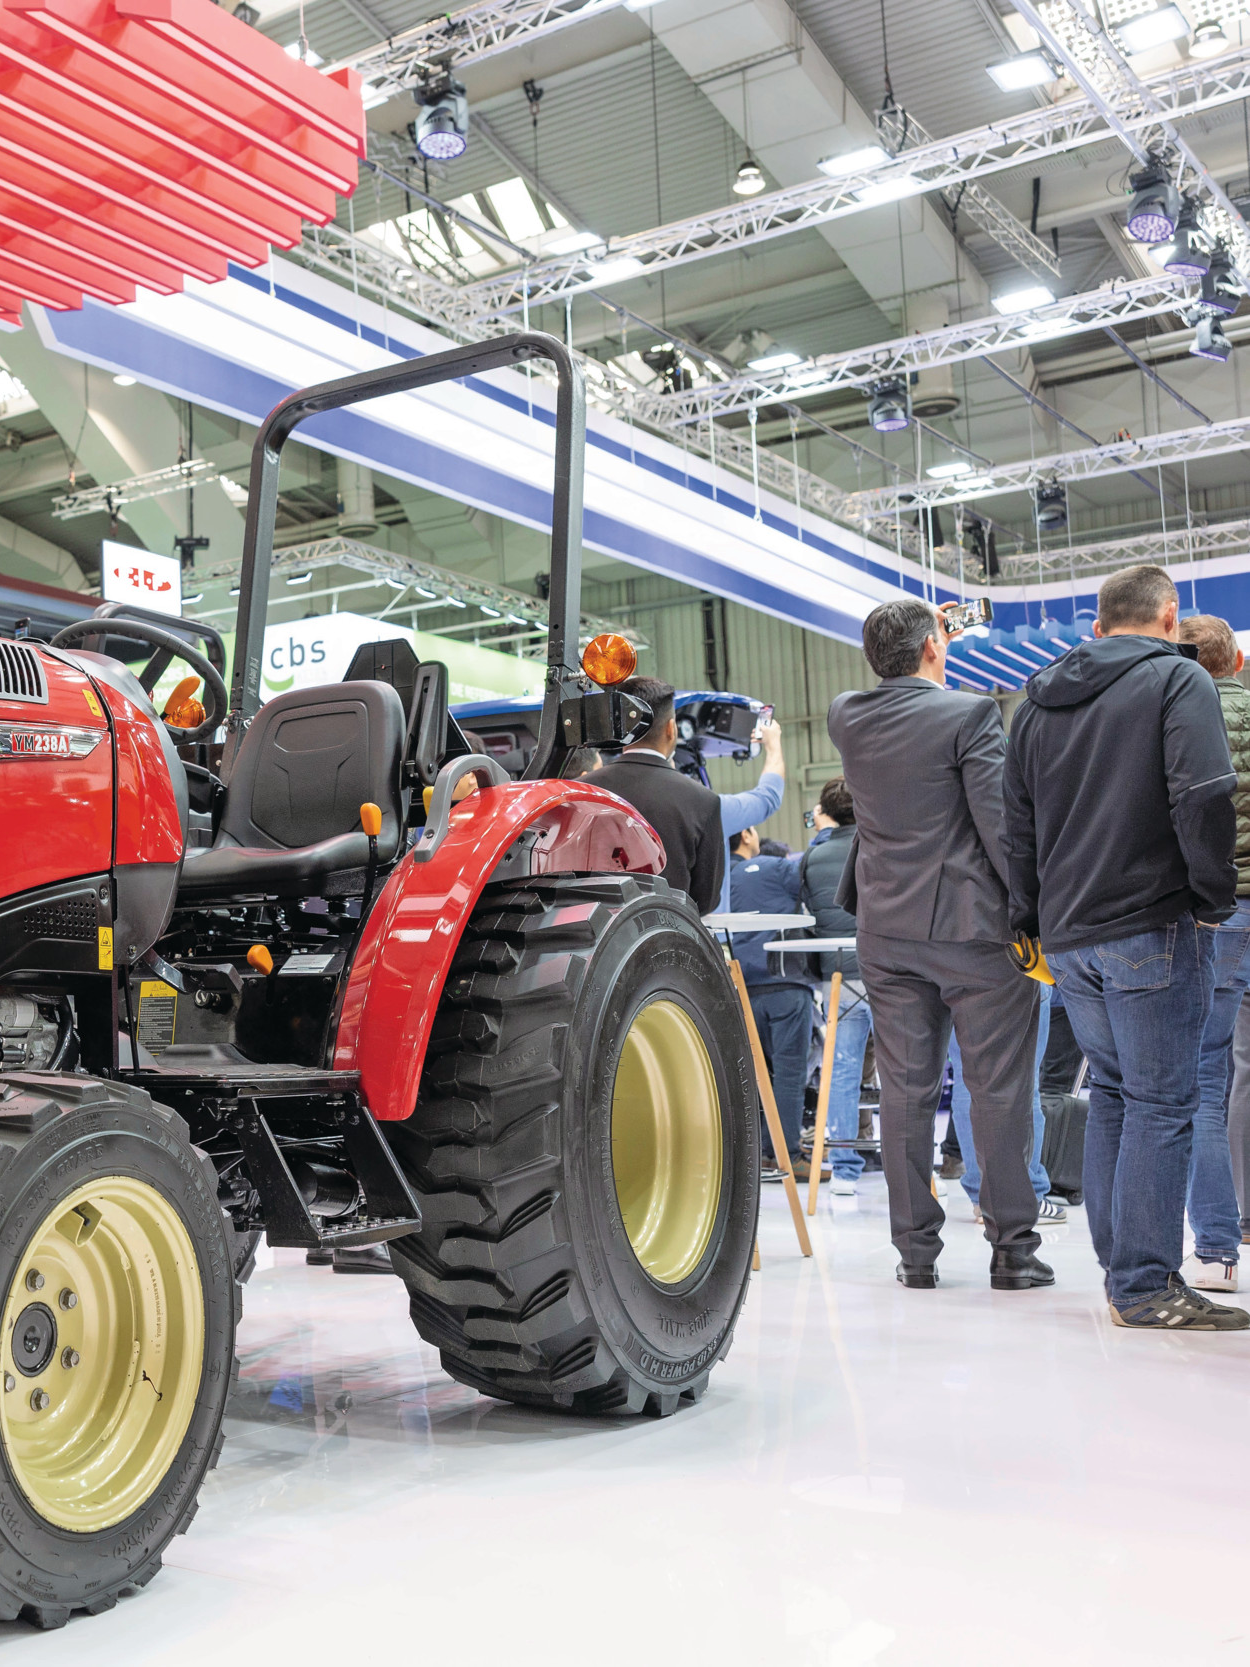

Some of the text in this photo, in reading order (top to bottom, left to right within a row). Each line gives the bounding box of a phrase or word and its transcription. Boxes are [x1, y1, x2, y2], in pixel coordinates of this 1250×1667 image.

[270, 636, 326, 670] cbs
[14, 734, 69, 754] YM238A
[639, 1347, 661, 1375] H.D.
[660, 1359, 696, 1378] POWER
